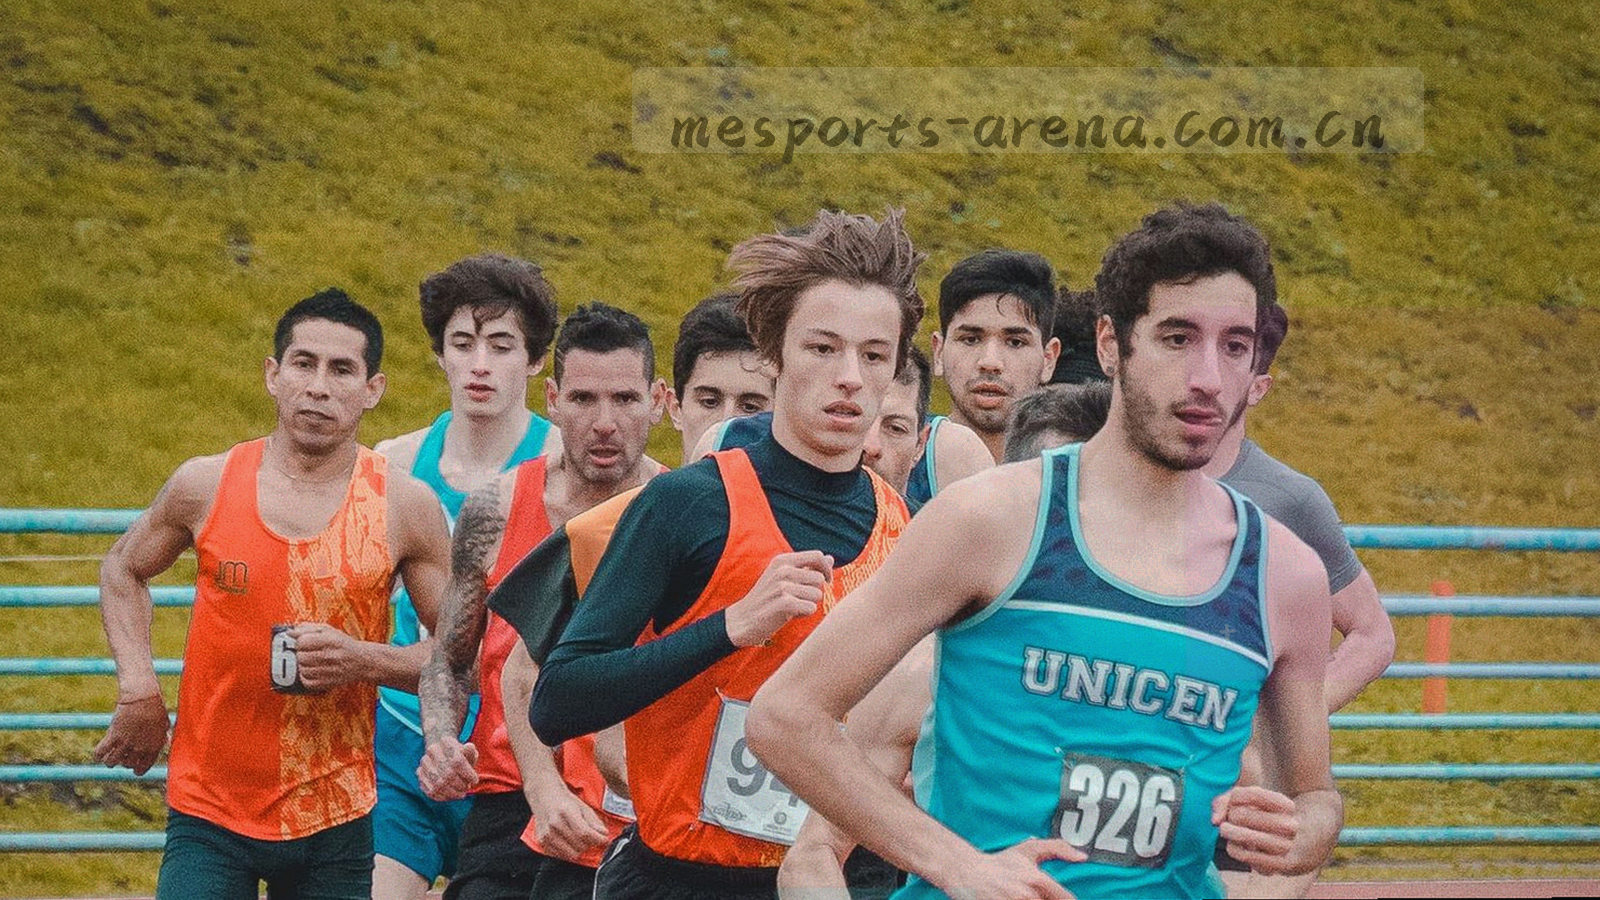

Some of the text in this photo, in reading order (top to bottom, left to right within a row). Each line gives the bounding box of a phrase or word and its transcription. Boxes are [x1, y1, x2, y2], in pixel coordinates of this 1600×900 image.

[1021, 645, 1240, 733] UNICEN
[726, 736, 800, 808] 9
[1059, 763, 1176, 858] 326
